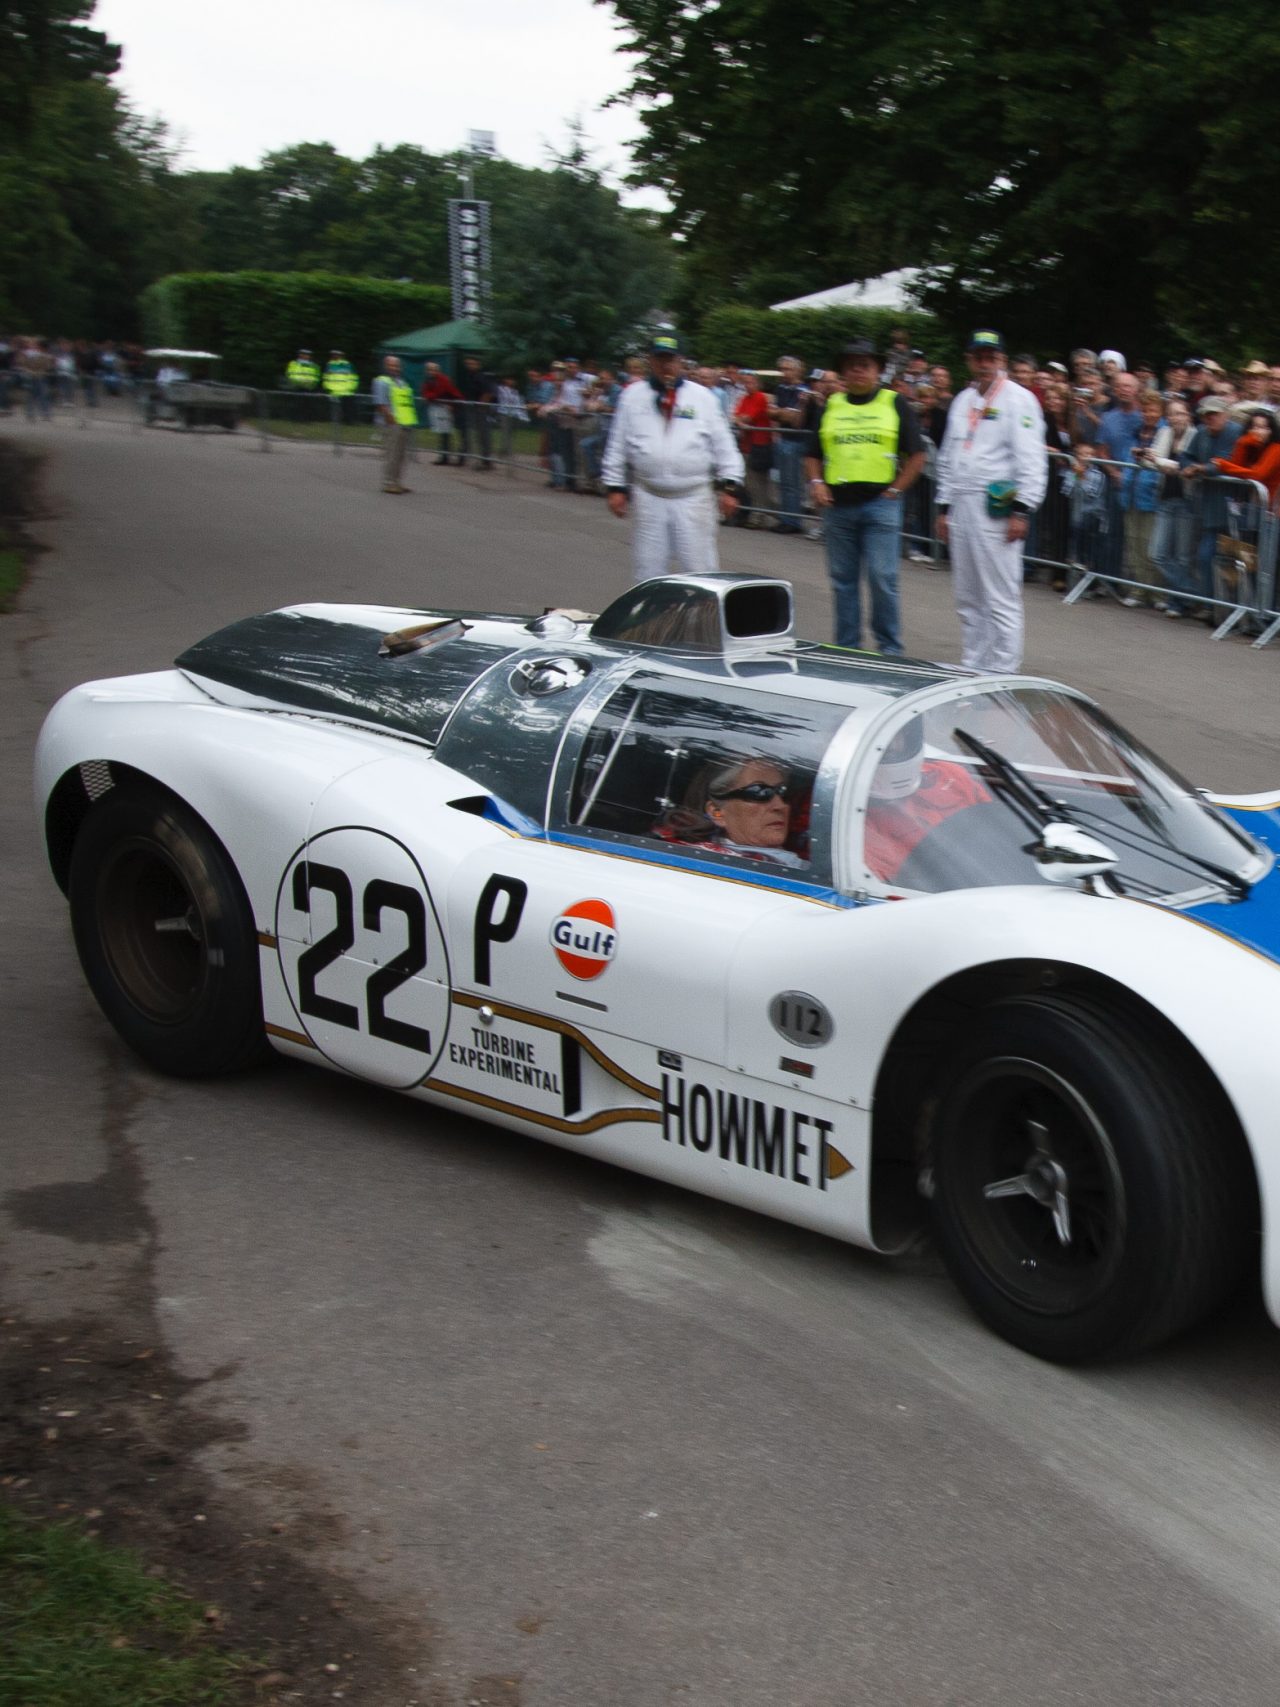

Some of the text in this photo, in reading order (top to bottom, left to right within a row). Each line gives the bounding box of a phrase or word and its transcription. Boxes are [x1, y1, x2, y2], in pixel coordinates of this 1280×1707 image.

[473, 873, 528, 986] P
[554, 920, 615, 956] Gulf
[293, 860, 431, 1055] 22
[471, 1027, 535, 1064] TURBINE
[779, 1000, 822, 1037] 112
[449, 1042, 561, 1096] EXPERIMENTAL
[660, 1071, 834, 1192] HOWMET
